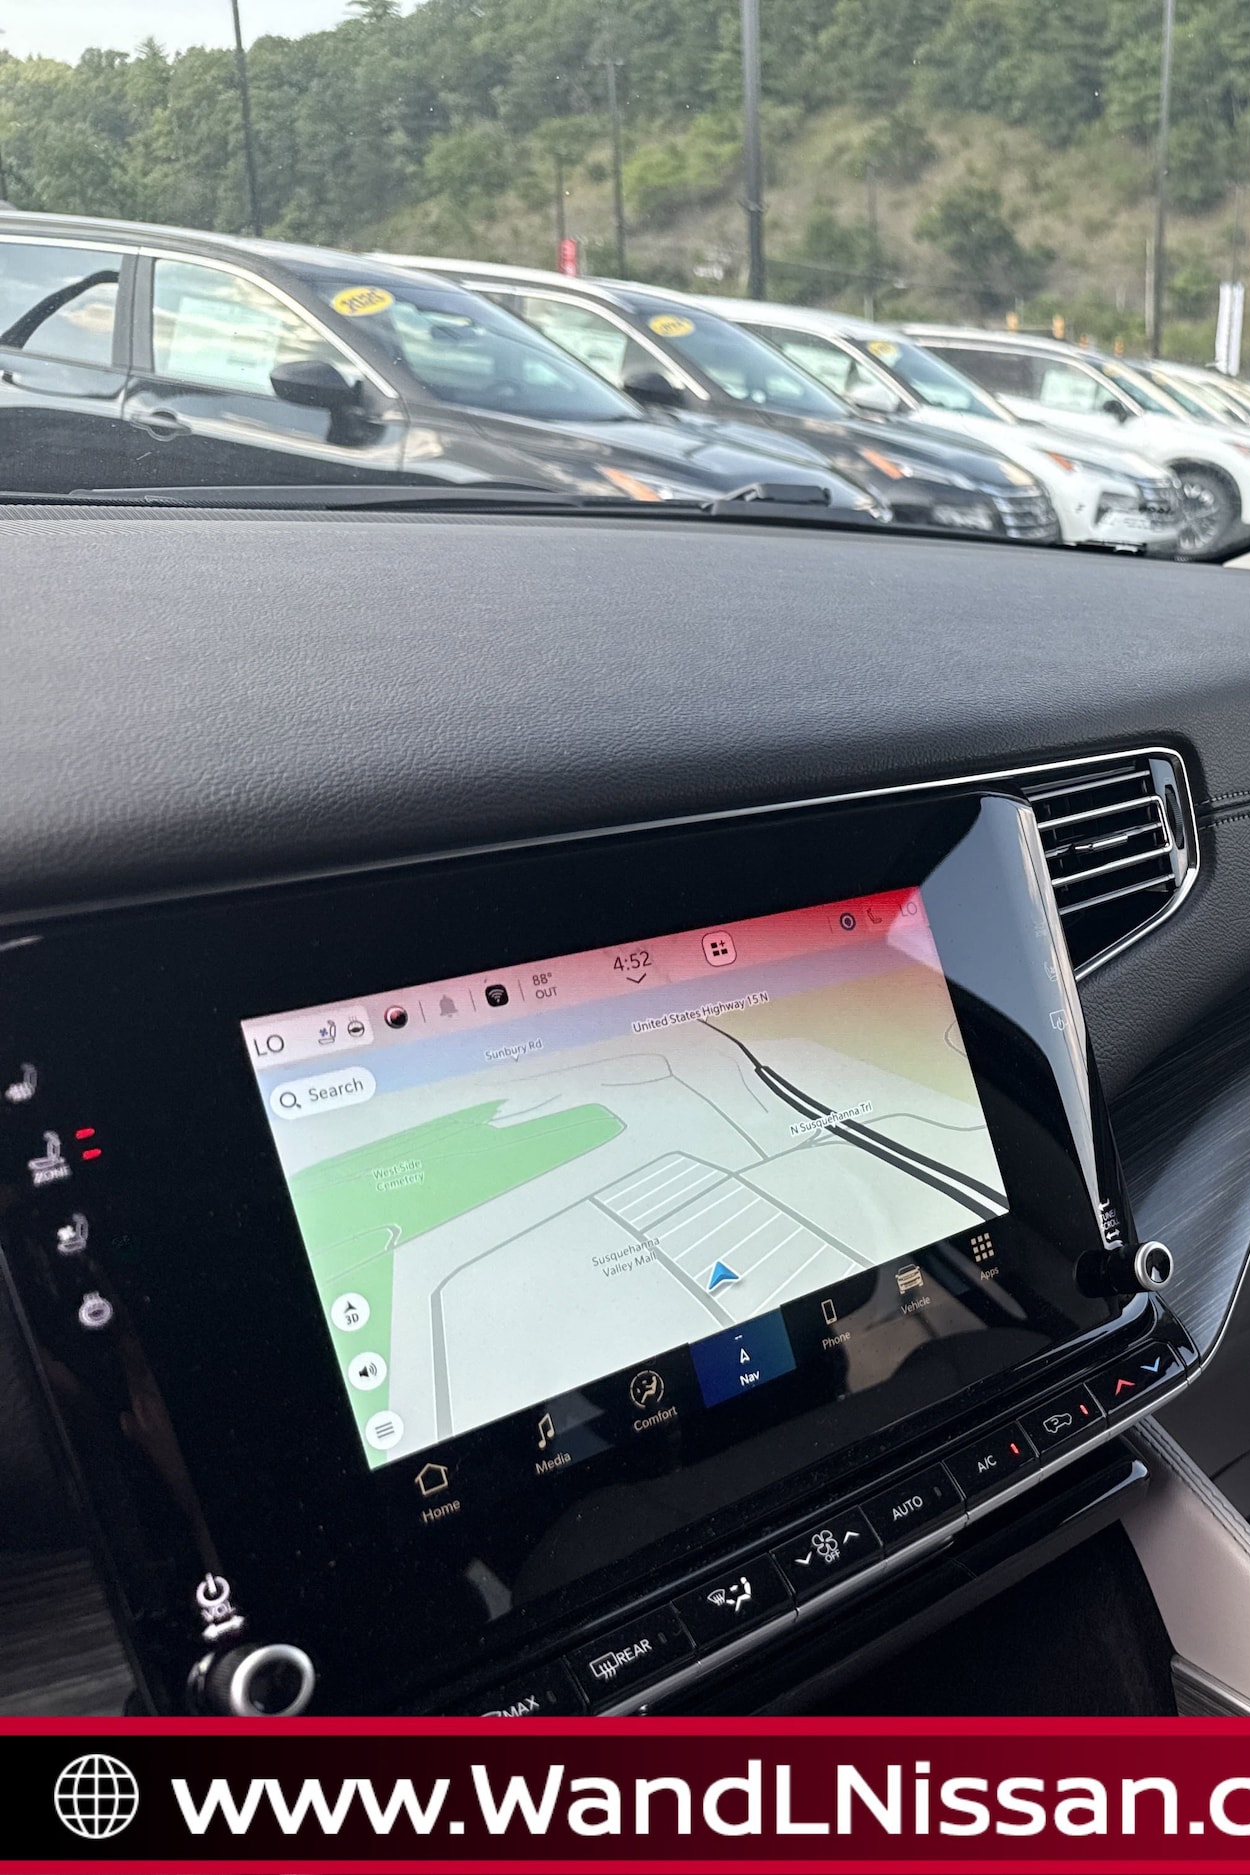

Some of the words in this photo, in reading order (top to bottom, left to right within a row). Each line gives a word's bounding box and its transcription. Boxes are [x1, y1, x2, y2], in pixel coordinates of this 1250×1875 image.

[613, 951, 653, 972] 4:52
[535, 987, 558, 1000] OUT
[633, 1015, 669, 1033] United
[670, 1009, 702, 1024] States
[702, 999, 745, 1017] Highway
[747, 995, 759, 1006] 15
[760, 992, 769, 1002] N
[254, 1034, 285, 1057] LO
[485, 1043, 527, 1060] Sunbury
[529, 1039, 543, 1050] Rd
[308, 1076, 364, 1103] Search
[790, 1125, 799, 1136] N
[800, 1108, 860, 1132] Susquehanna
[860, 1102, 873, 1113] Trl
[373, 1165, 398, 1179] West
[399, 1160, 422, 1172] Side
[376, 1172, 424, 1191] Cemetery
[591, 1237, 660, 1267] Susquehanna
[602, 1261, 633, 1278] Valley
[634, 1251, 657, 1267] Mall
[980, 1266, 1000, 1282] Apps
[901, 1294, 932, 1316] Vehicle
[345, 1311, 360, 1325] 3D
[822, 1330, 852, 1350] Phone
[739, 1369, 761, 1387] Nav
[633, 1406, 677, 1432] Comfort
[535, 1451, 572, 1476] Media
[976, 1454, 998, 1474] A/C
[423, 1500, 460, 1523] Home
[891, 1495, 924, 1522] AUTO
[825, 1548, 842, 1564] OFF
[617, 1639, 652, 1665] REAR
[503, 1695, 540, 1716] MAX
